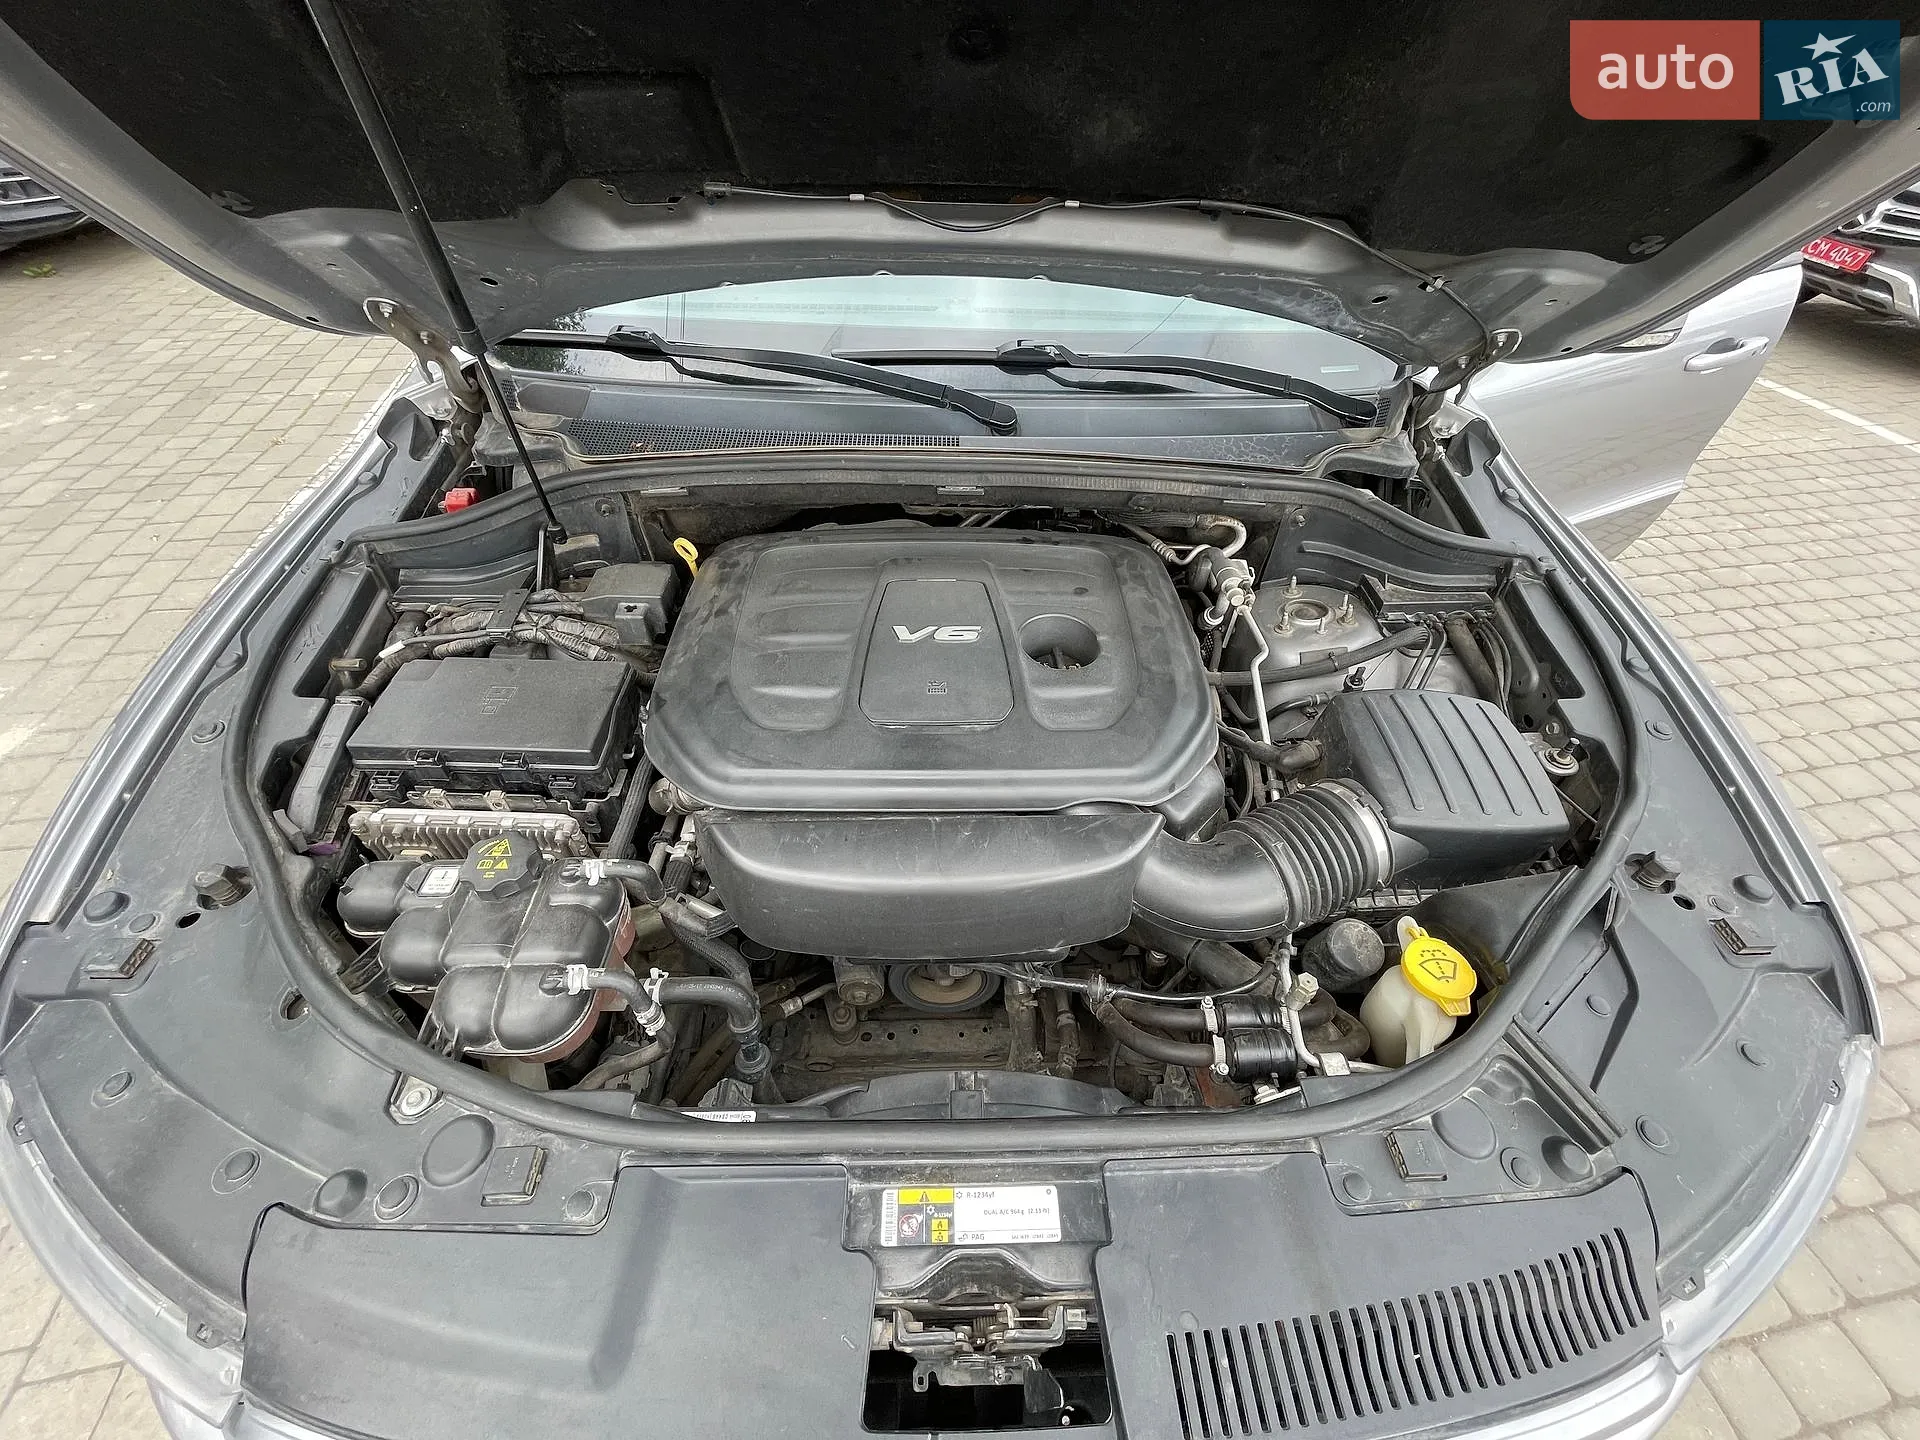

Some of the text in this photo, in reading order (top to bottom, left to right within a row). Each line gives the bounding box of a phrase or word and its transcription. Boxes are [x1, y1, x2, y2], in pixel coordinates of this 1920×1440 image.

[1808, 239, 1865, 267] CM 4047
[891, 624, 983, 644] V6
[971, 1233, 985, 1241] PAG
